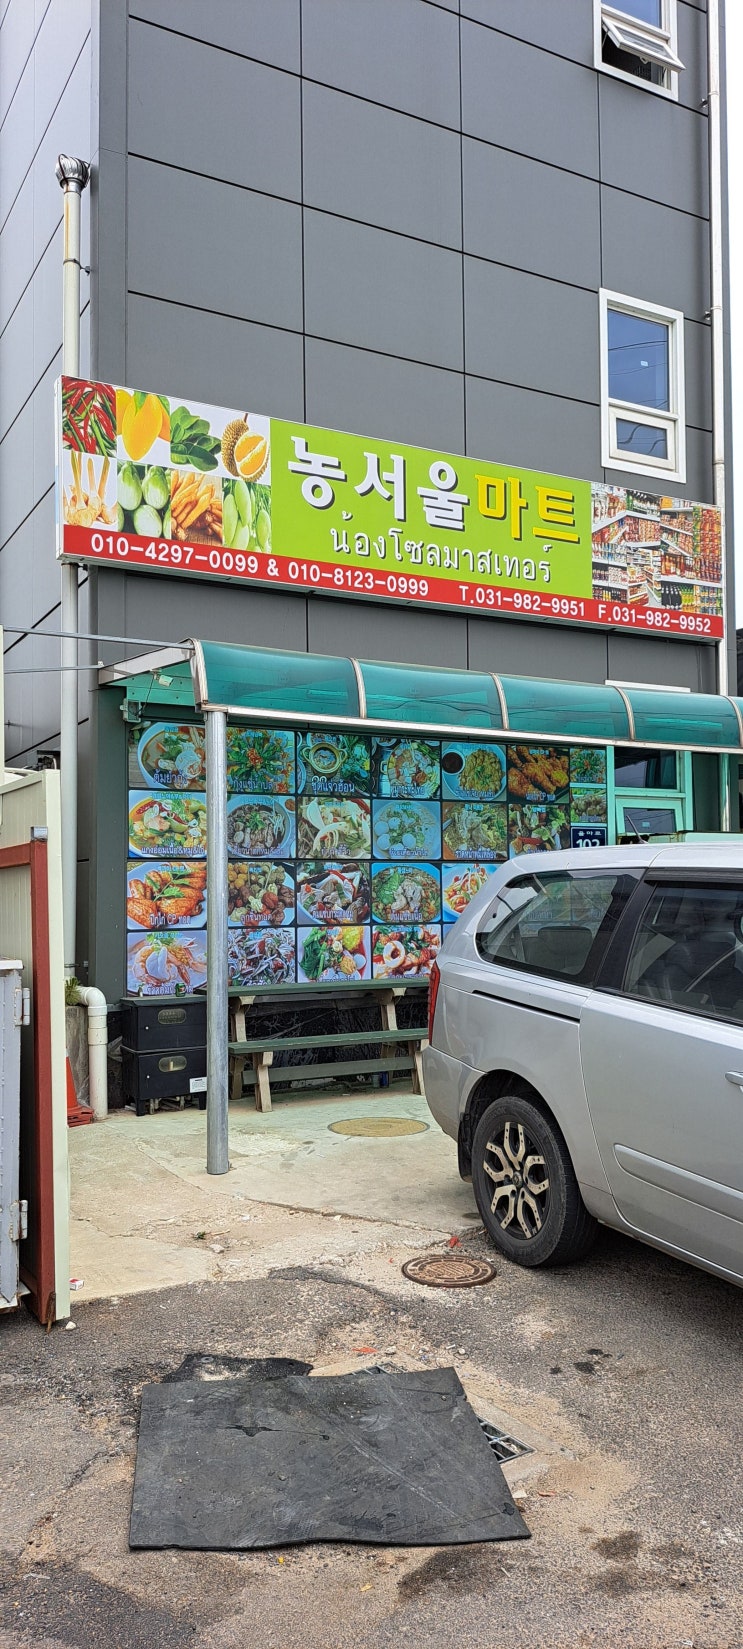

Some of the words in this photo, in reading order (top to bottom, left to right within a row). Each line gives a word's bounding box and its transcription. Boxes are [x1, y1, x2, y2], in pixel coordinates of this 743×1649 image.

[287, 435, 580, 543] 농서울마트
[90, 532, 259, 573] 010-4297-0099
[267, 559, 280, 577] &
[288, 560, 429, 596] 010-8123-0999
[458, 584, 586, 617] T.031-982-9951
[598, 605, 711, 633] F.031-982-9952
[330, 510, 552, 583] น้องโซลมาสเทอร์
[167, 913, 177, 924] CP
